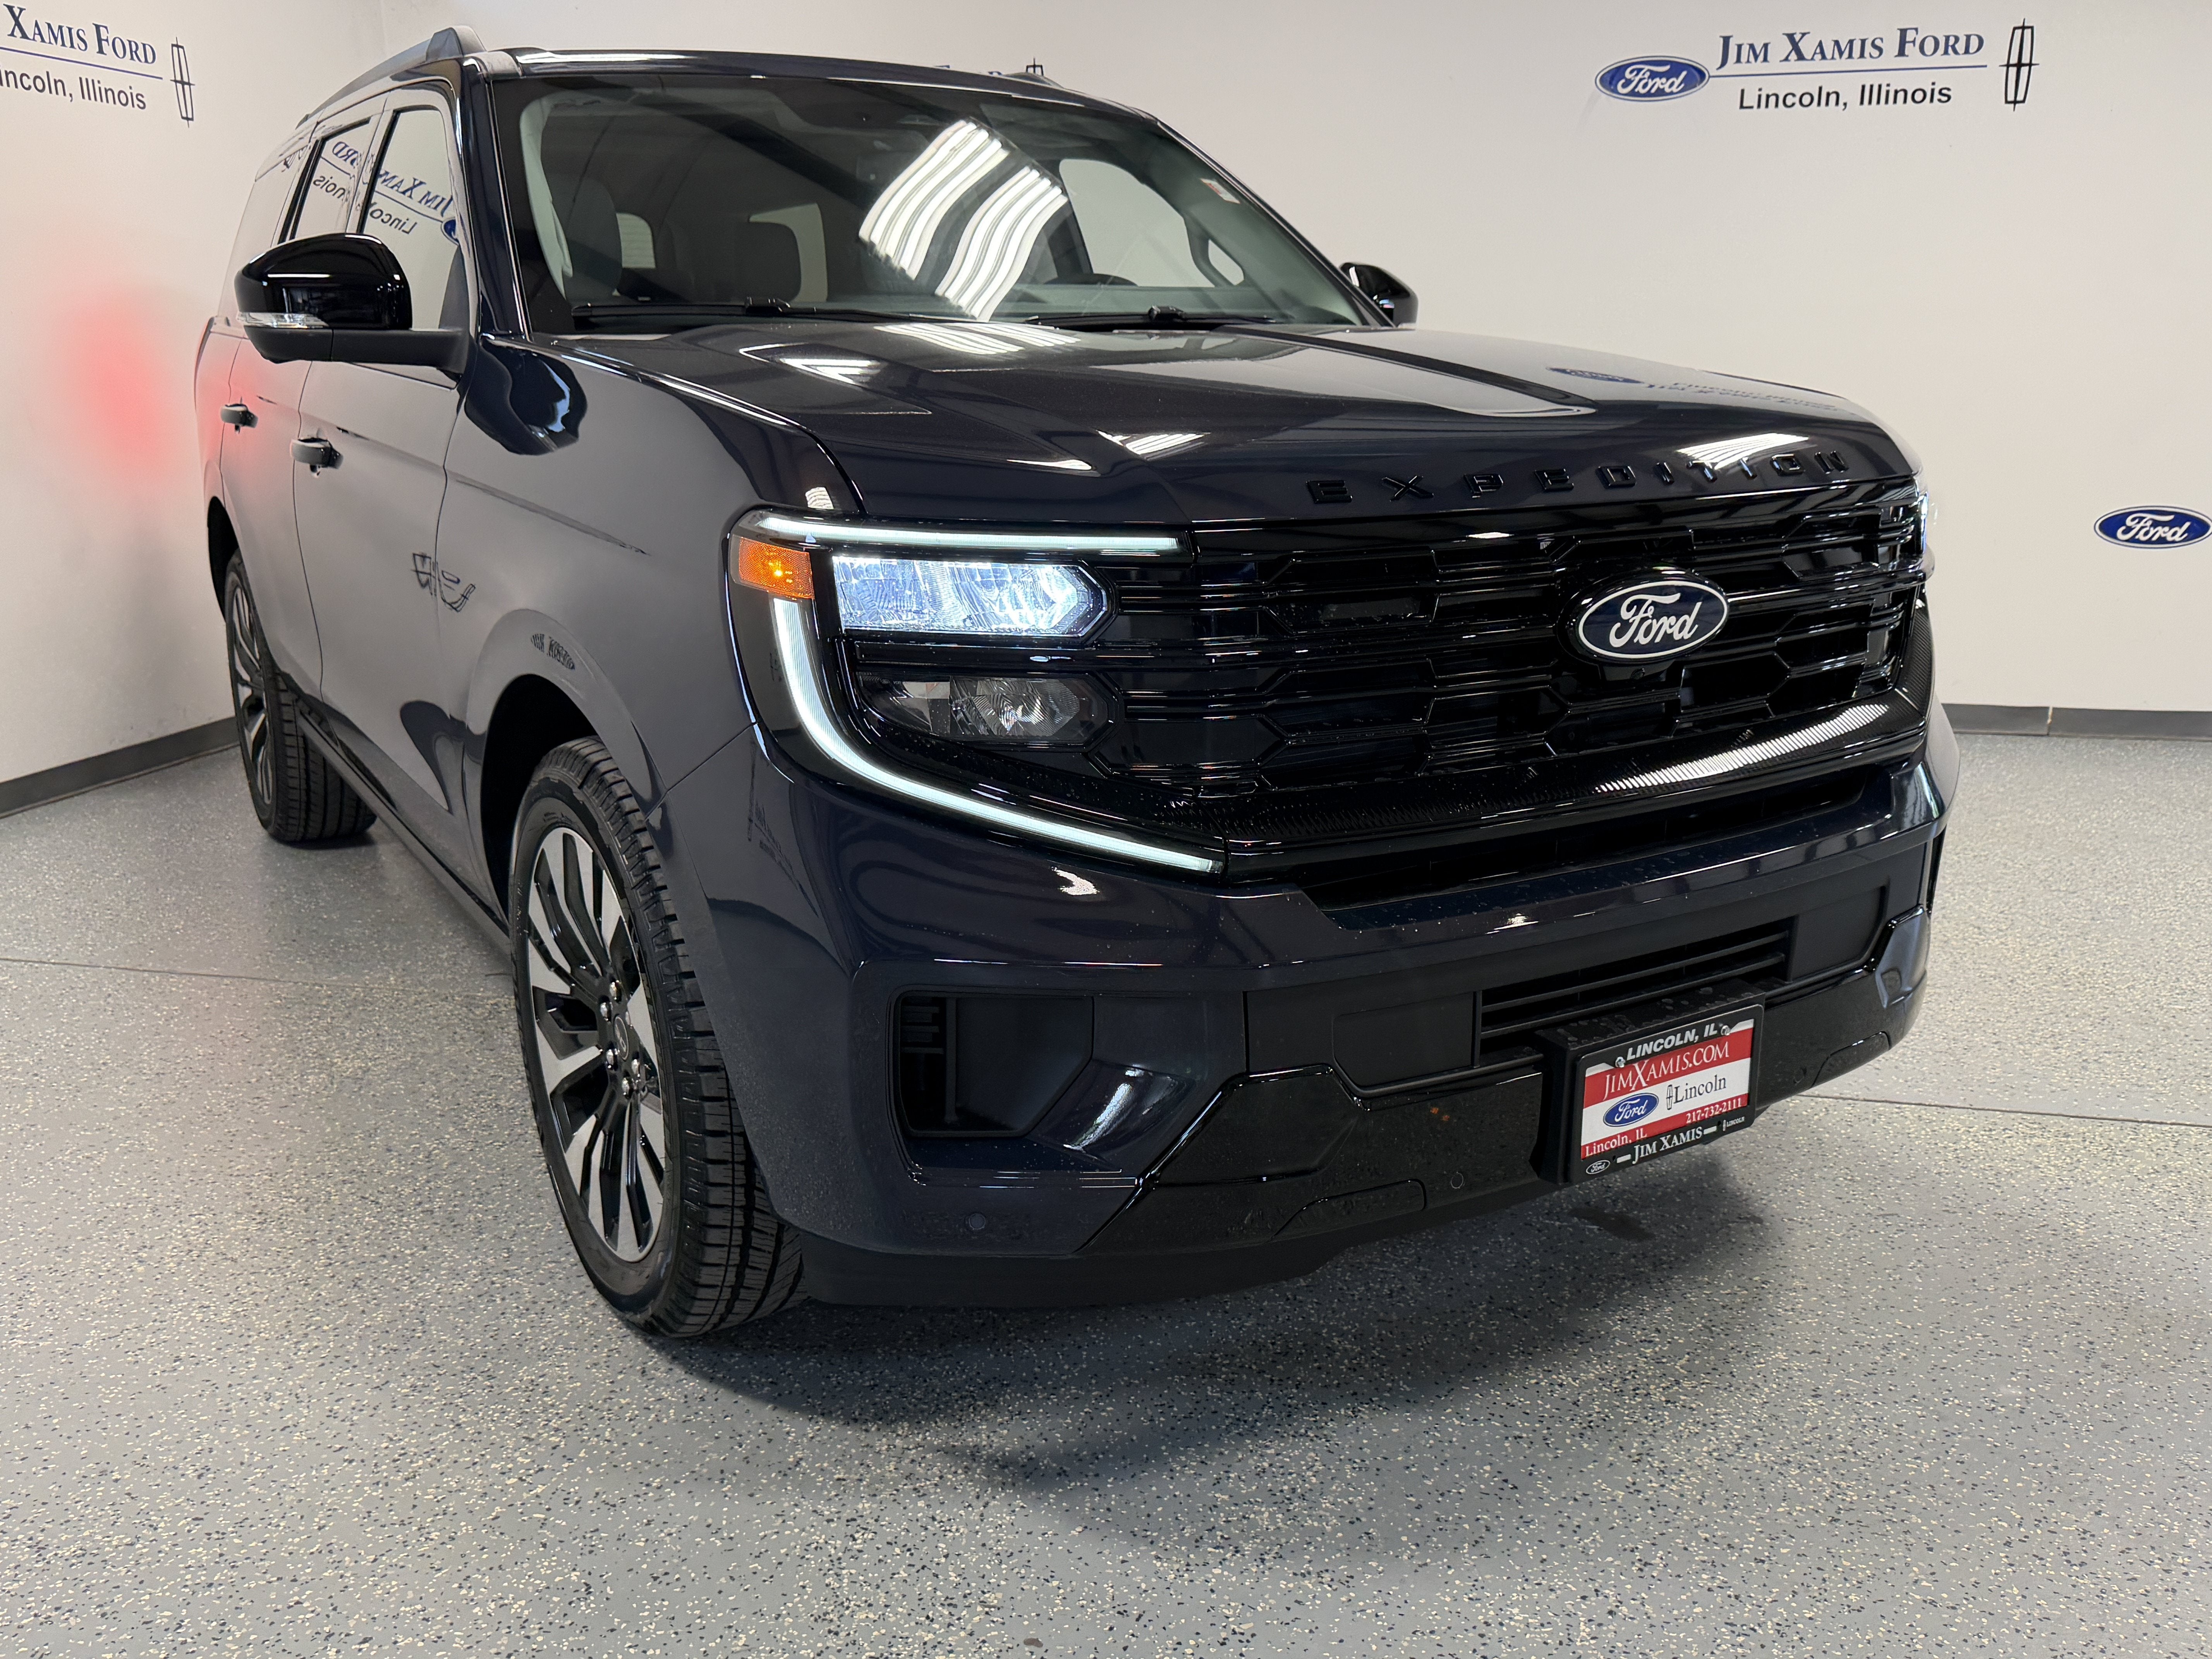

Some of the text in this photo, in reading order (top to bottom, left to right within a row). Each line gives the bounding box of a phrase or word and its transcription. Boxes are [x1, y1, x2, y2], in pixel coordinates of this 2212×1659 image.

[3, 4, 156, 64] XAMIS FORD
[1716, 27, 1984, 70] JIM XAMIS FORD
[0, 64, 146, 110] incoln, Illinois
[1617, 64, 1688, 94] Ford
[1739, 82, 1952, 111] Lincoln, Illinois
[1306, 450, 1850, 504] EXPEDITION
[2117, 513, 2191, 542] Ford
[1609, 592, 1702, 647] Ford
[1626, 1023, 1717, 1061] LINCOLN, IL
[1602, 1041, 1729, 1101] JIMXAMIS.COM
[1673, 1074, 1726, 1104] Lincoln
[1614, 1098, 1648, 1122] Ford
[1686, 1097, 1741, 1124] 217-732-2111
[1585, 1128, 1647, 1158] Lincoln, IL
[1632, 1127, 1702, 1164] JIM XAMIS
[1591, 1162, 1606, 1173] Ford
